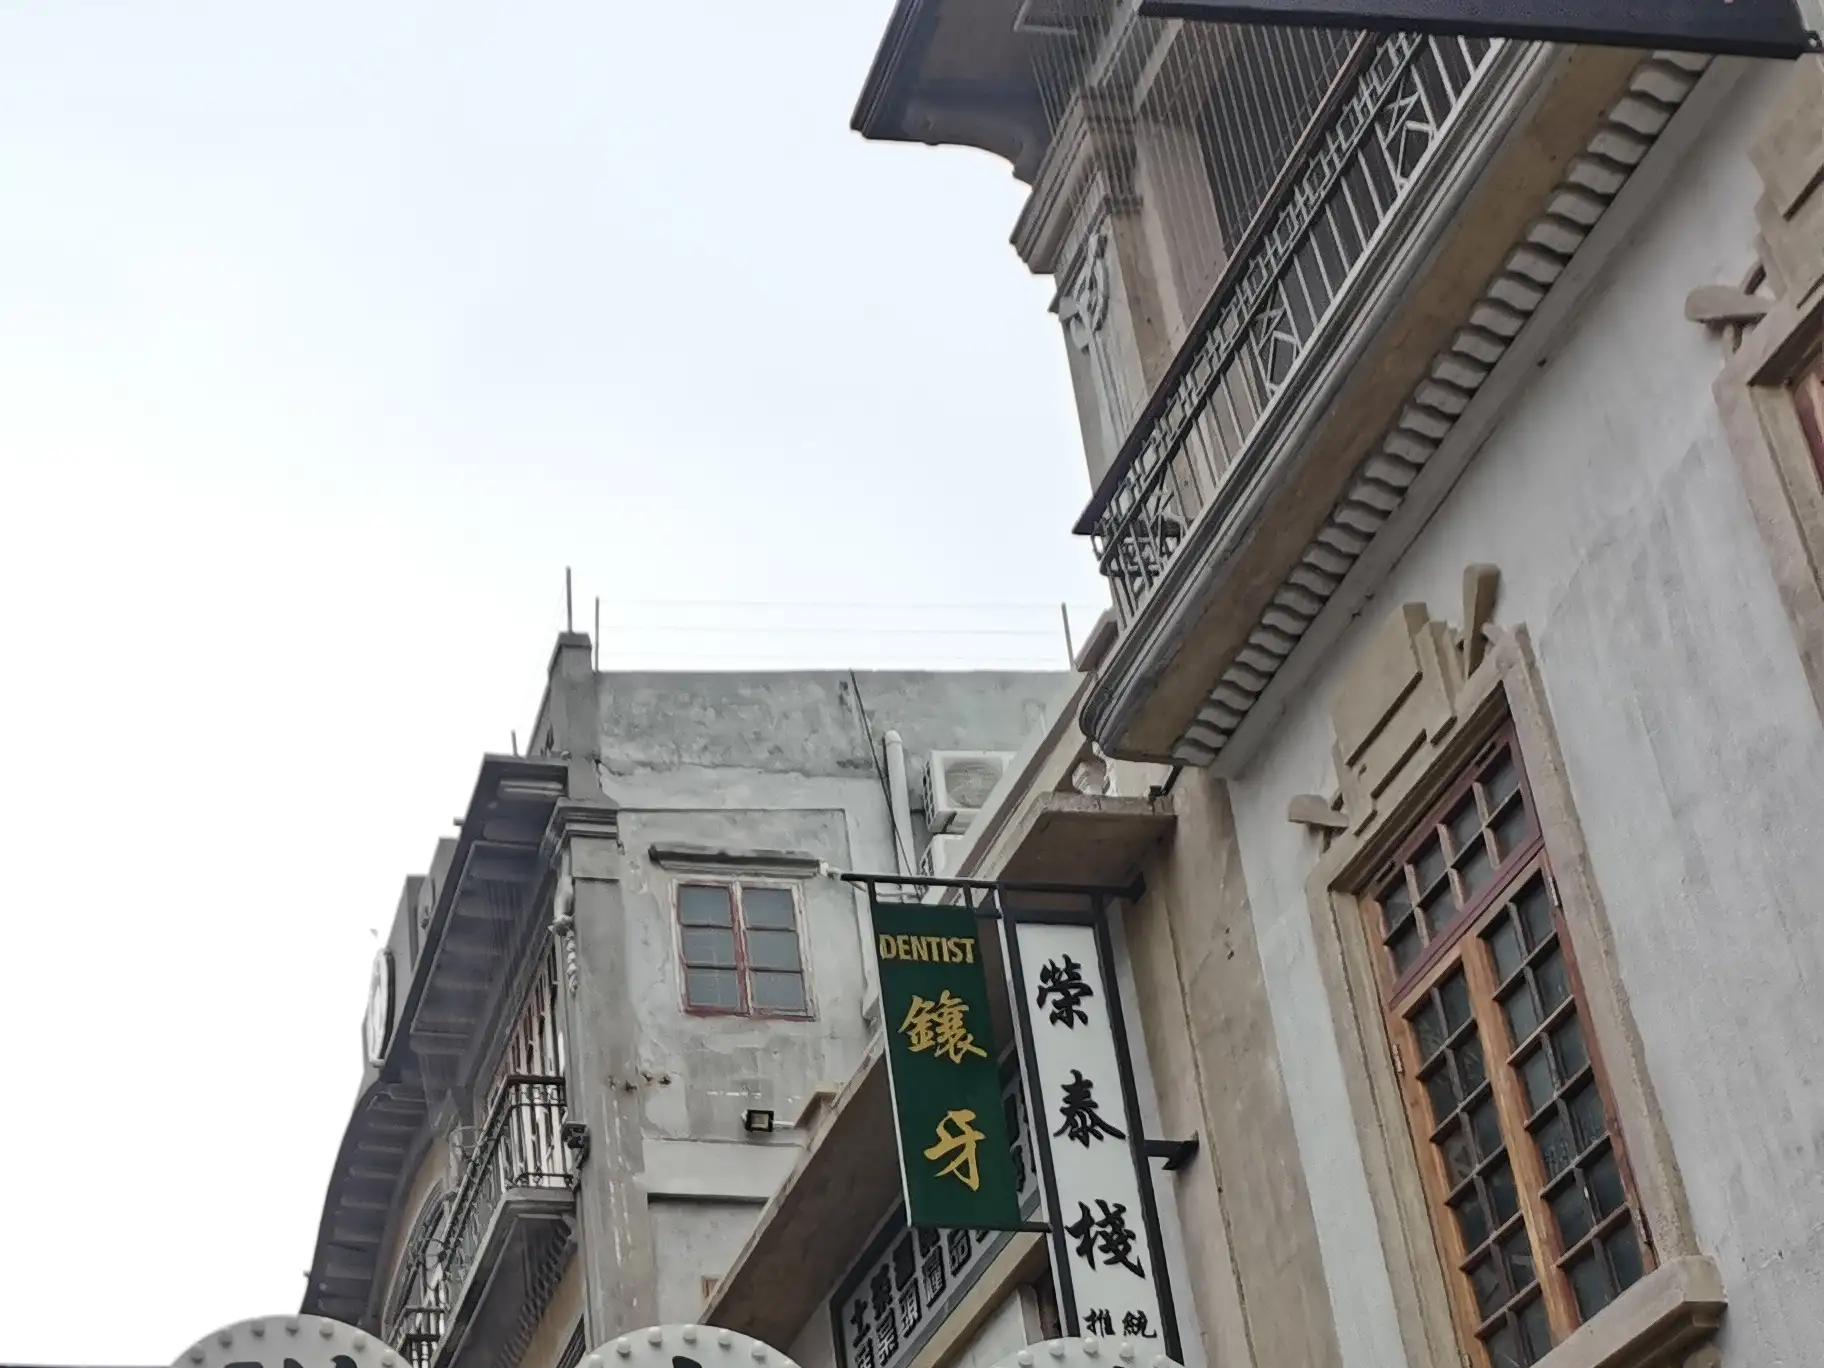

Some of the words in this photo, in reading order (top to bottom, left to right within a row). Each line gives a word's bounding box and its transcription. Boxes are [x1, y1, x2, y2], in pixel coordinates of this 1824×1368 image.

[878, 932, 977, 967] DENTIST
[897, 992, 988, 1193] 鑲牙
[1035, 952, 1146, 1280] 榮泰棧
